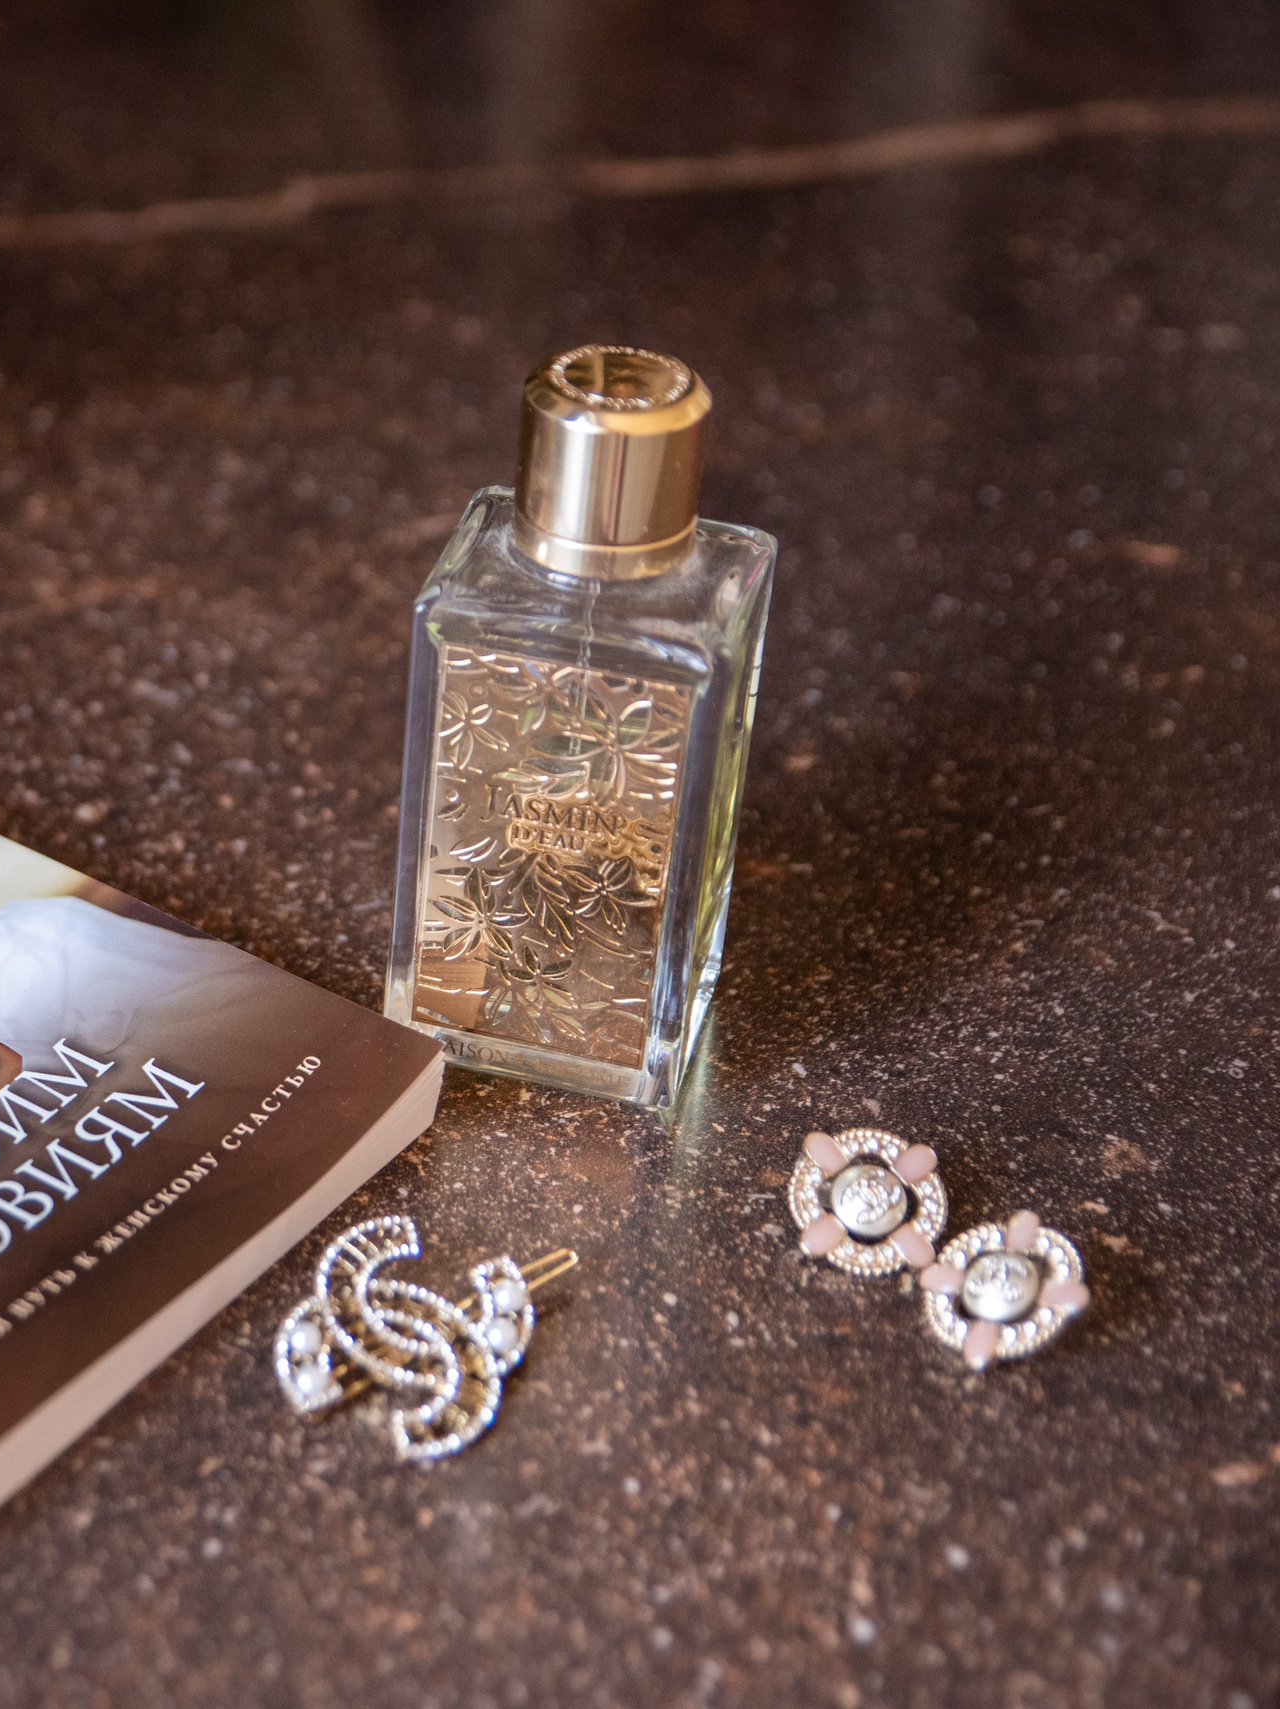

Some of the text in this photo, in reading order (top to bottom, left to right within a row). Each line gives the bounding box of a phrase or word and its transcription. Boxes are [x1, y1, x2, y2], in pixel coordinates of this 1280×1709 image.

[438, 1037, 509, 1063] AISON
[94, 1152, 218, 1254] ЖЕНСКОМУ
[221, 1056, 321, 1150] СЧАСТЬЮ
